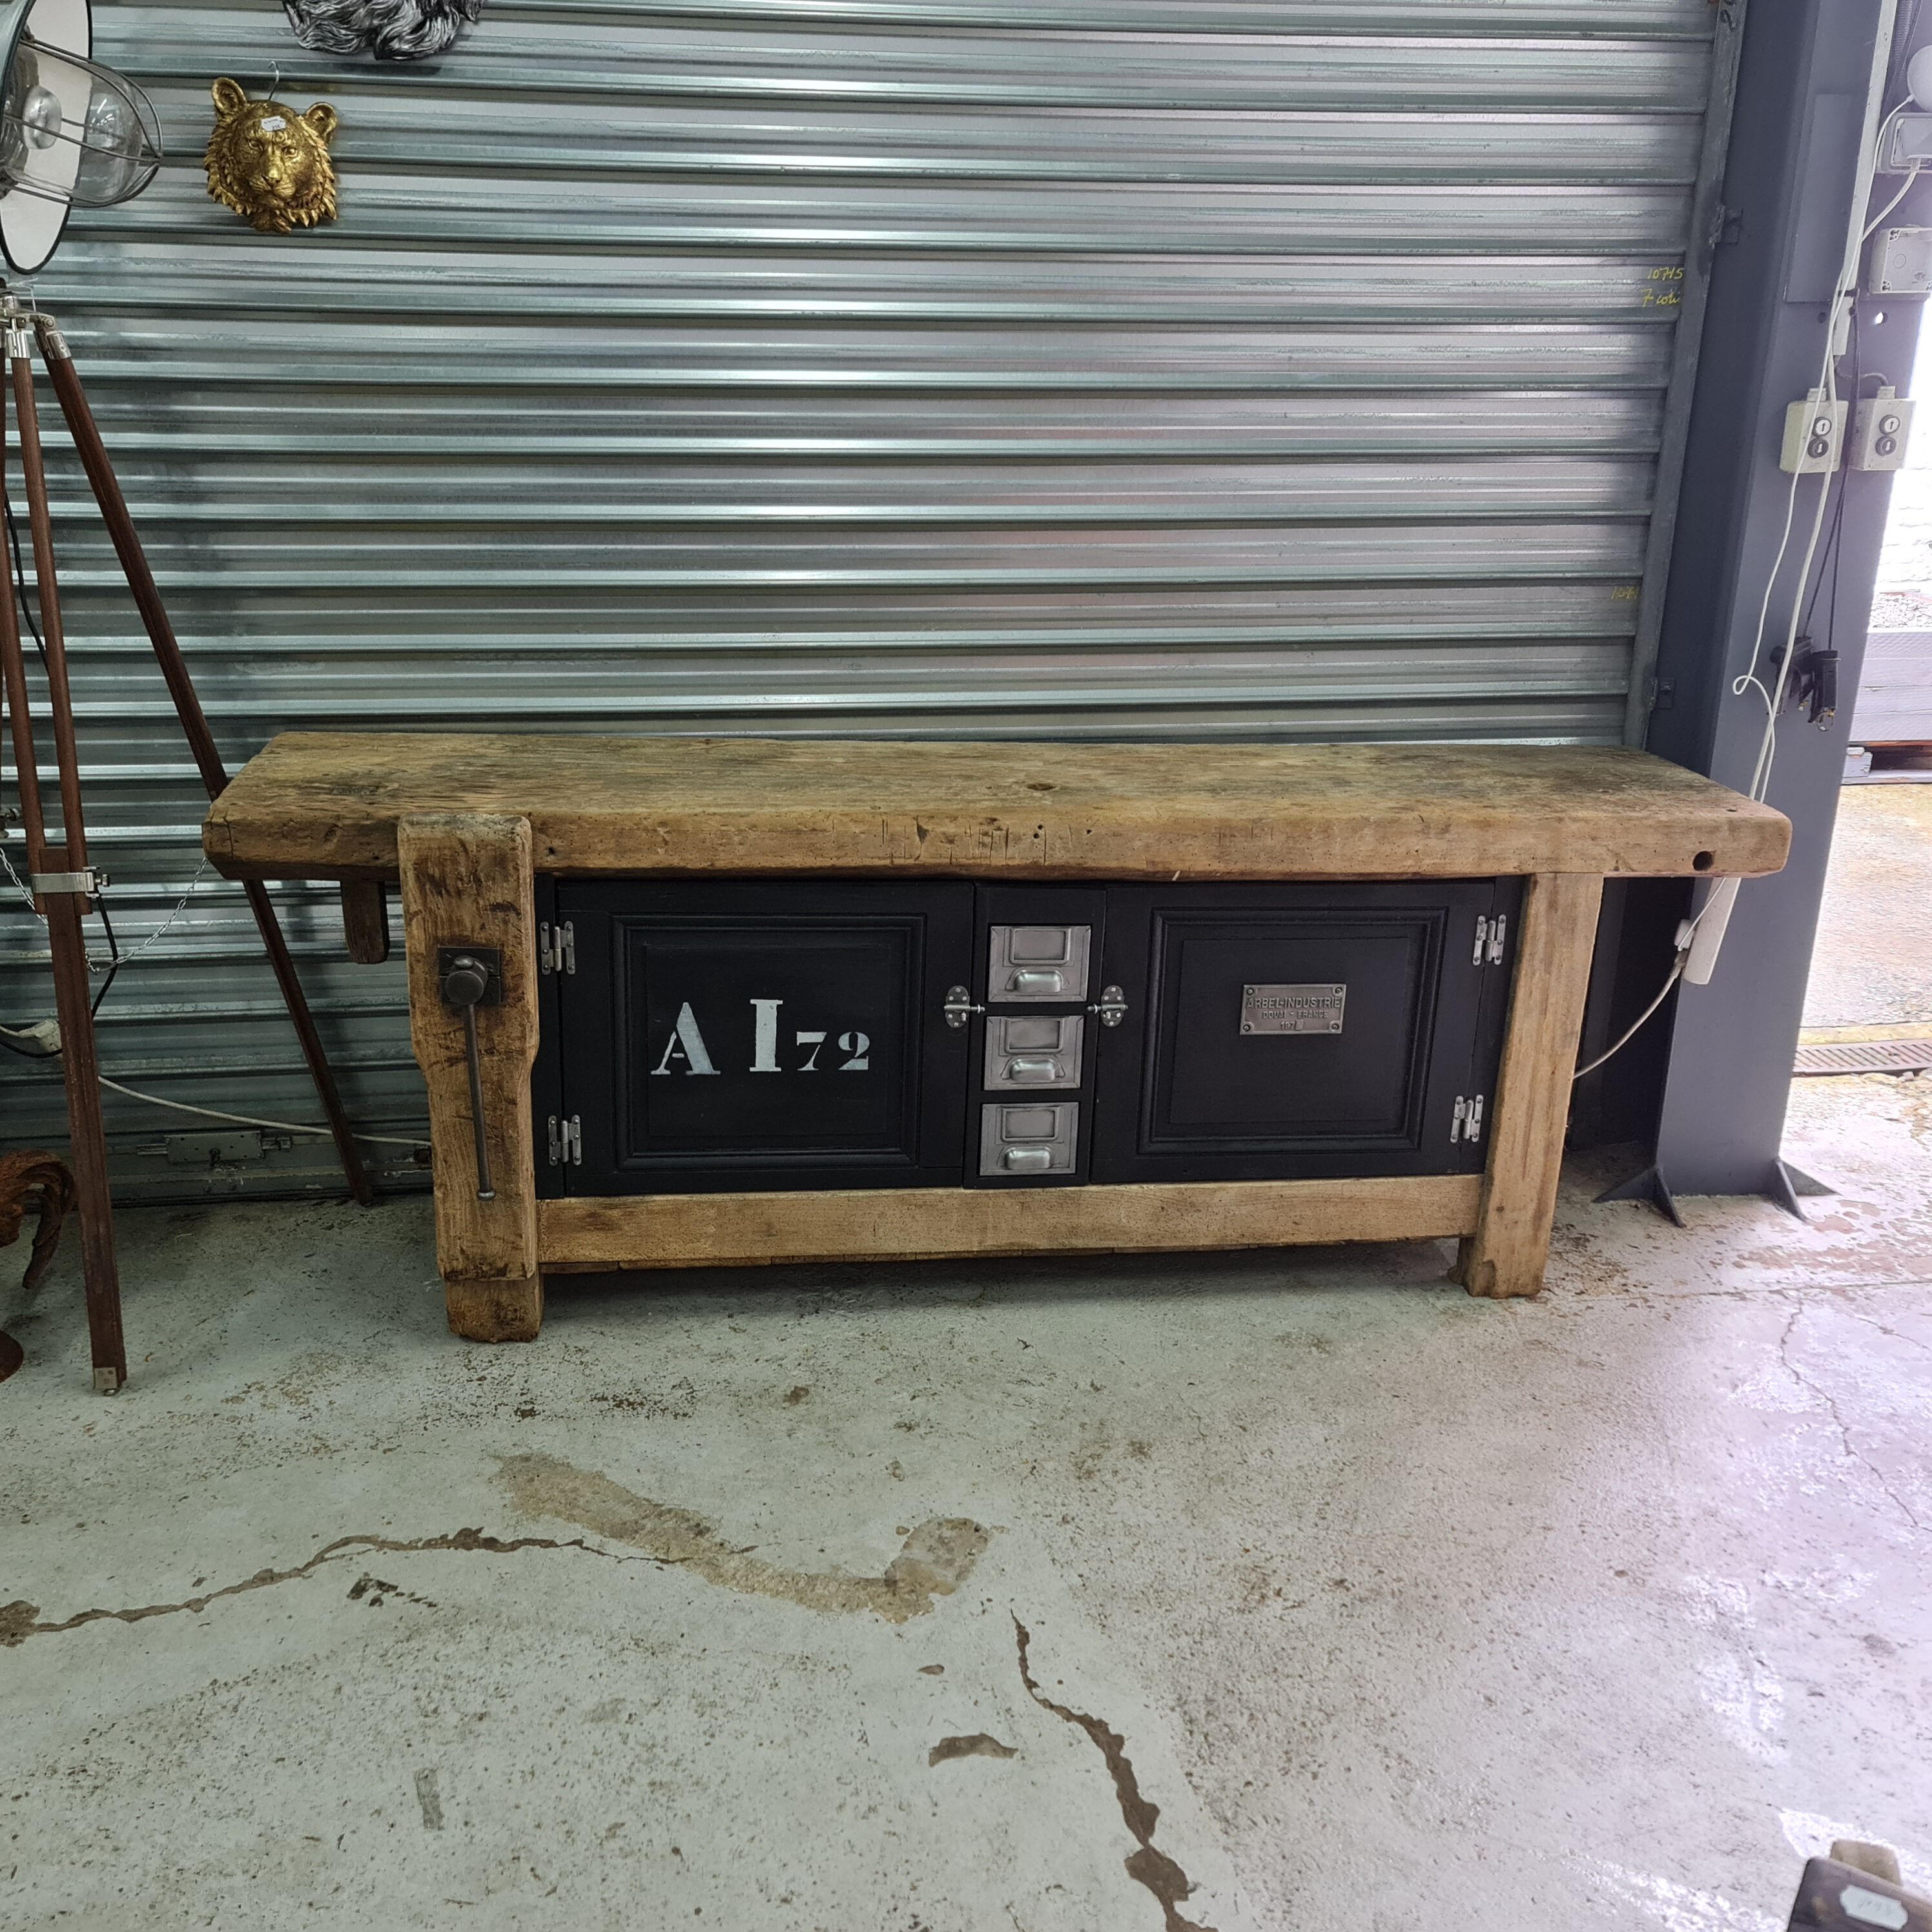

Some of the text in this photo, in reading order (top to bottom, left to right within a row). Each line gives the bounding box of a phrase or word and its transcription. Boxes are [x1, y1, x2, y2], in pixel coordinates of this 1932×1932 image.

[1246, 996, 1342, 1009] ARBEL-INDUSTRIE
[1262, 1010, 1288, 1019] DOUAI
[1297, 1009, 1329, 1018] FRANCE
